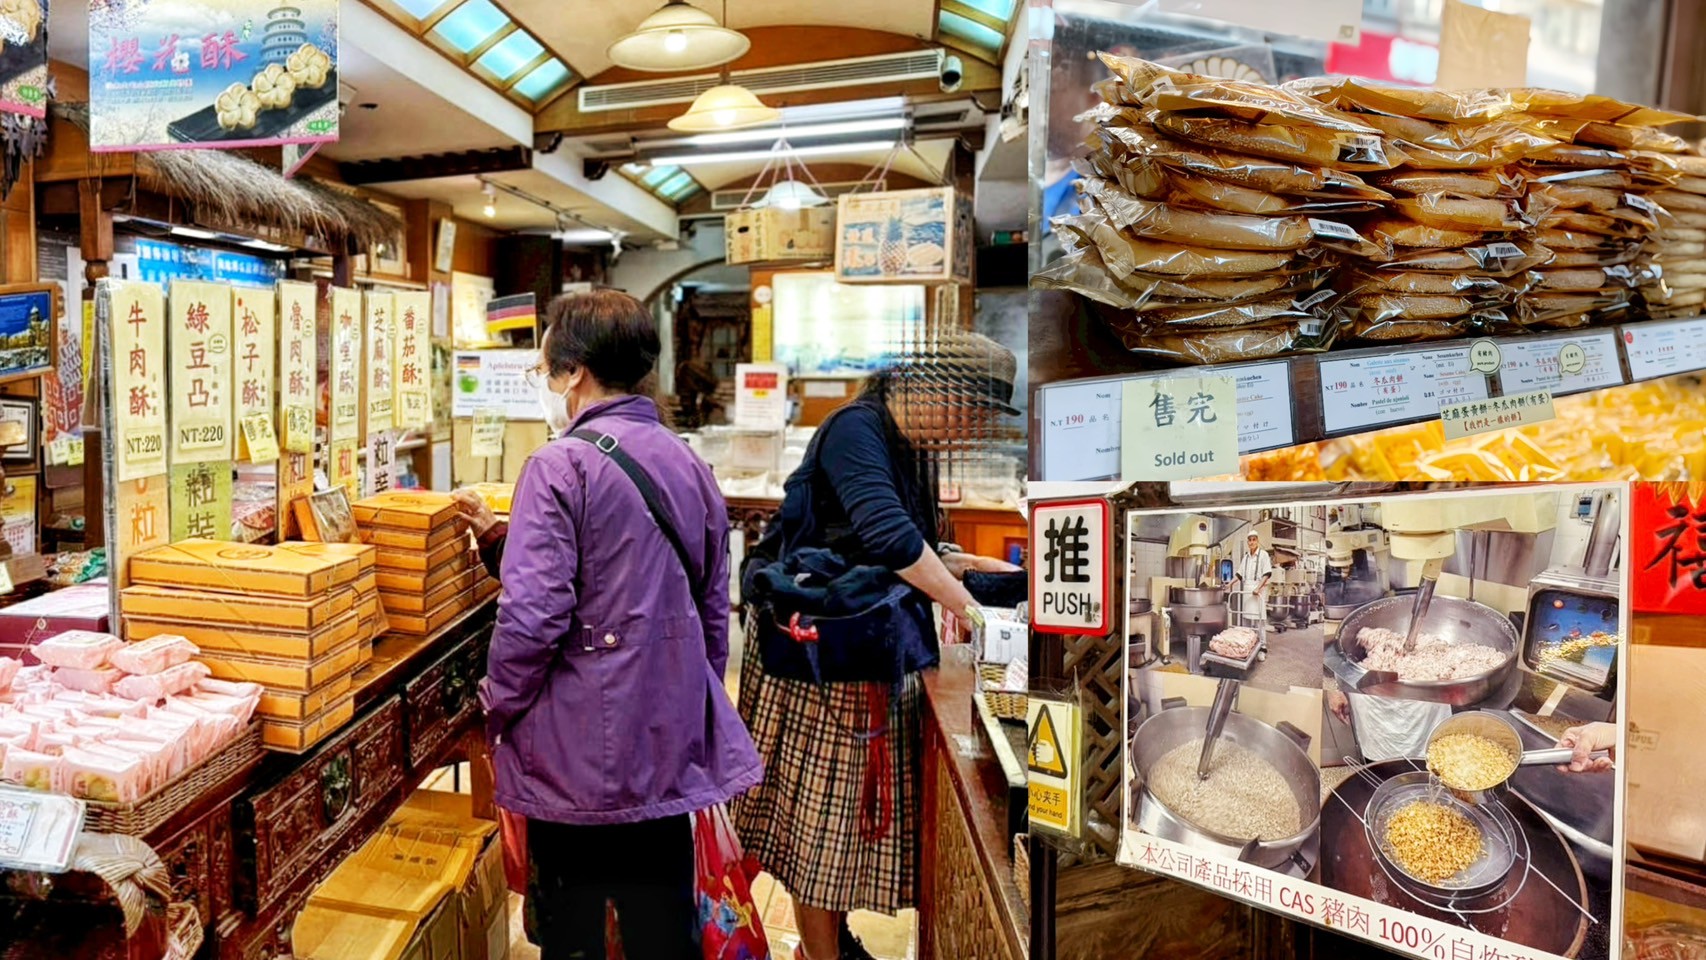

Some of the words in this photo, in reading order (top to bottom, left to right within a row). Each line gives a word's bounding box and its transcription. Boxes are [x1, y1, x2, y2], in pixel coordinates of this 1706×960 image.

[103, 29, 249, 76] 櫻花酥
[128, 300, 151, 418] 牛肉酥
[185, 301, 211, 408] 綠豆凸
[241, 307, 261, 408] 松子酥
[289, 301, 305, 397] 魯肉酥
[373, 308, 388, 392] 芝麻酥
[402, 306, 418, 387] 番茄酥
[1374, 374, 1403, 386] 冬瓜肉餅
[1507, 361, 1516, 369] 190
[1335, 381, 1347, 389] 190
[1065, 414, 1084, 425] 190
[1089, 413, 1110, 424] 品名
[1149, 391, 1217, 428] 售完
[127, 434, 162, 455] NT:220
[180, 425, 224, 444] NT:220
[1154, 451, 1186, 467] Sold
[1190, 450, 1214, 464] out
[1044, 515, 1091, 583] 推
[1043, 591, 1091, 616] PUSH
[1049, 809, 1063, 819] hand
[1140, 843, 1273, 905] 本公司產品採用
[1279, 885, 1314, 915] CAS
[1321, 895, 1369, 935] 豬肉
